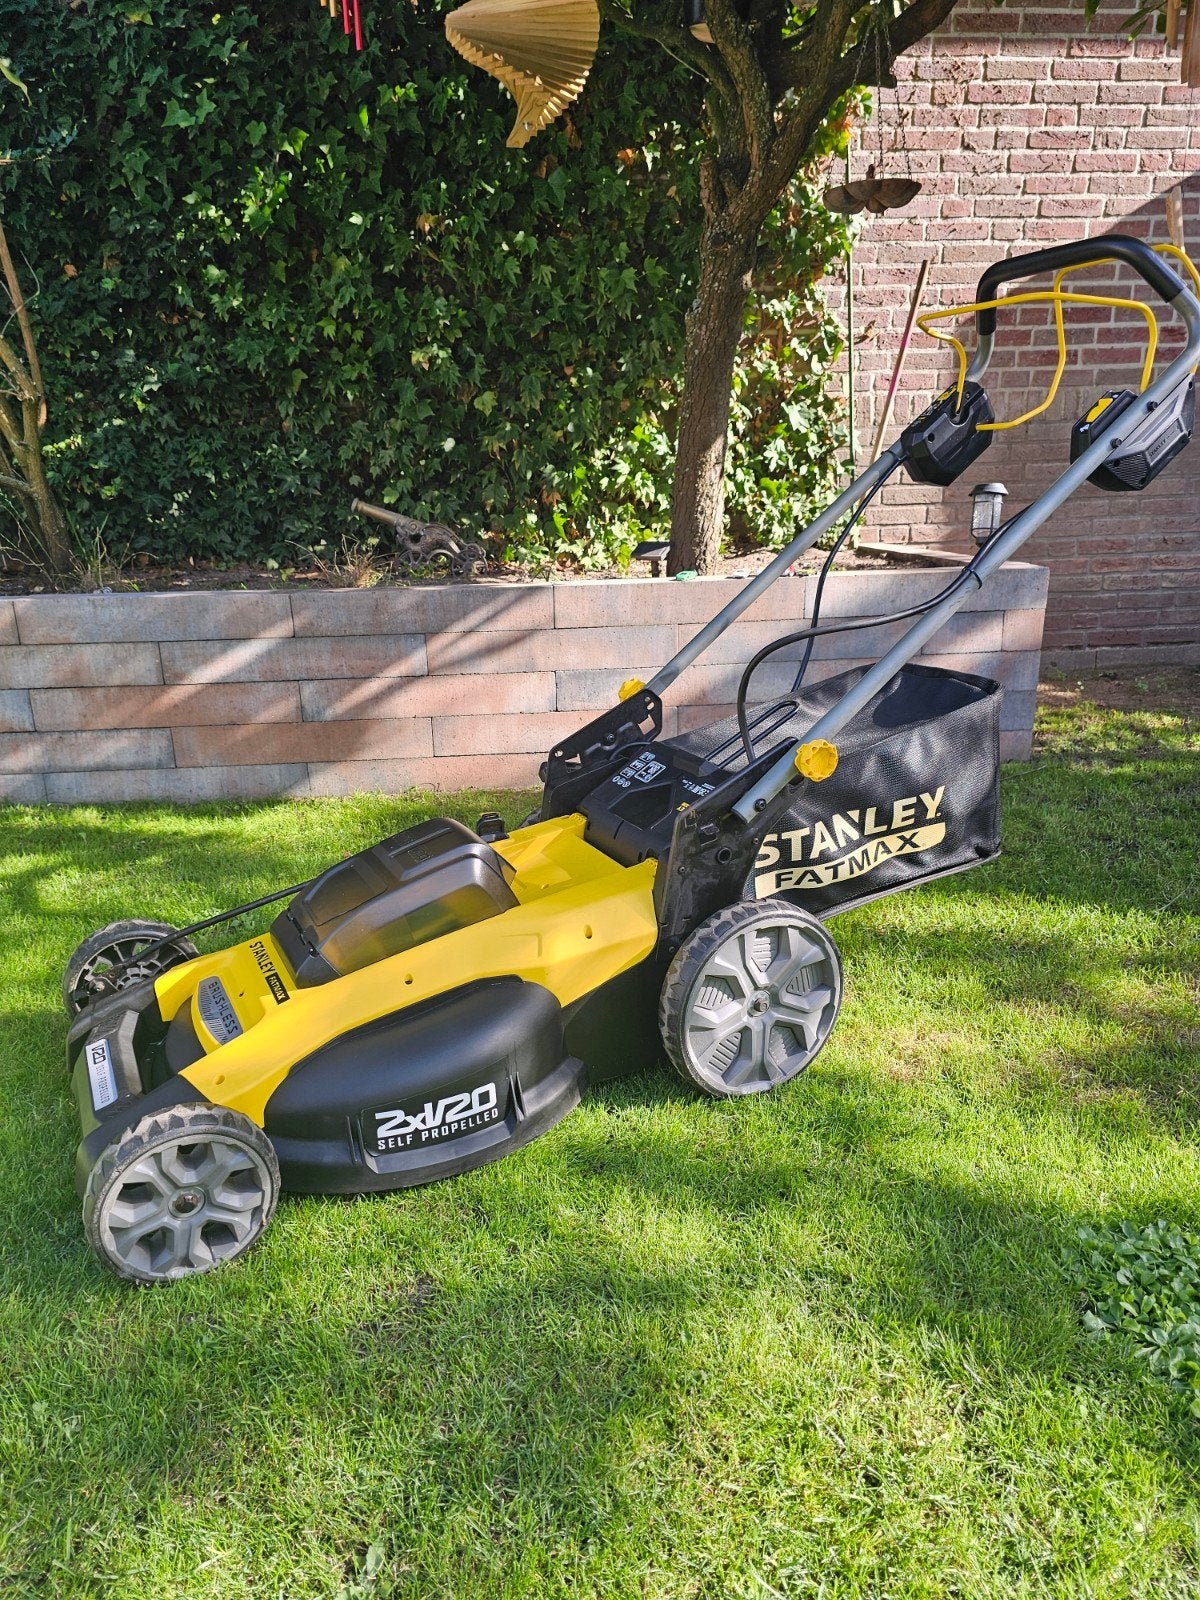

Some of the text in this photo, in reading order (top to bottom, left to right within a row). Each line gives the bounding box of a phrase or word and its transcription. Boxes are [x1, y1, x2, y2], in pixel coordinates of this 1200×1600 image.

[755, 785, 946, 869] STANLEY
[774, 831, 921, 889] FATMAX
[249, 941, 286, 1001] STANLEY FATMAX
[208, 981, 239, 1035] BRUSHLESS
[91, 1044, 107, 1065] V20
[374, 1082, 497, 1139] 2xV20
[378, 1107, 499, 1150] SELF PROPELLED
